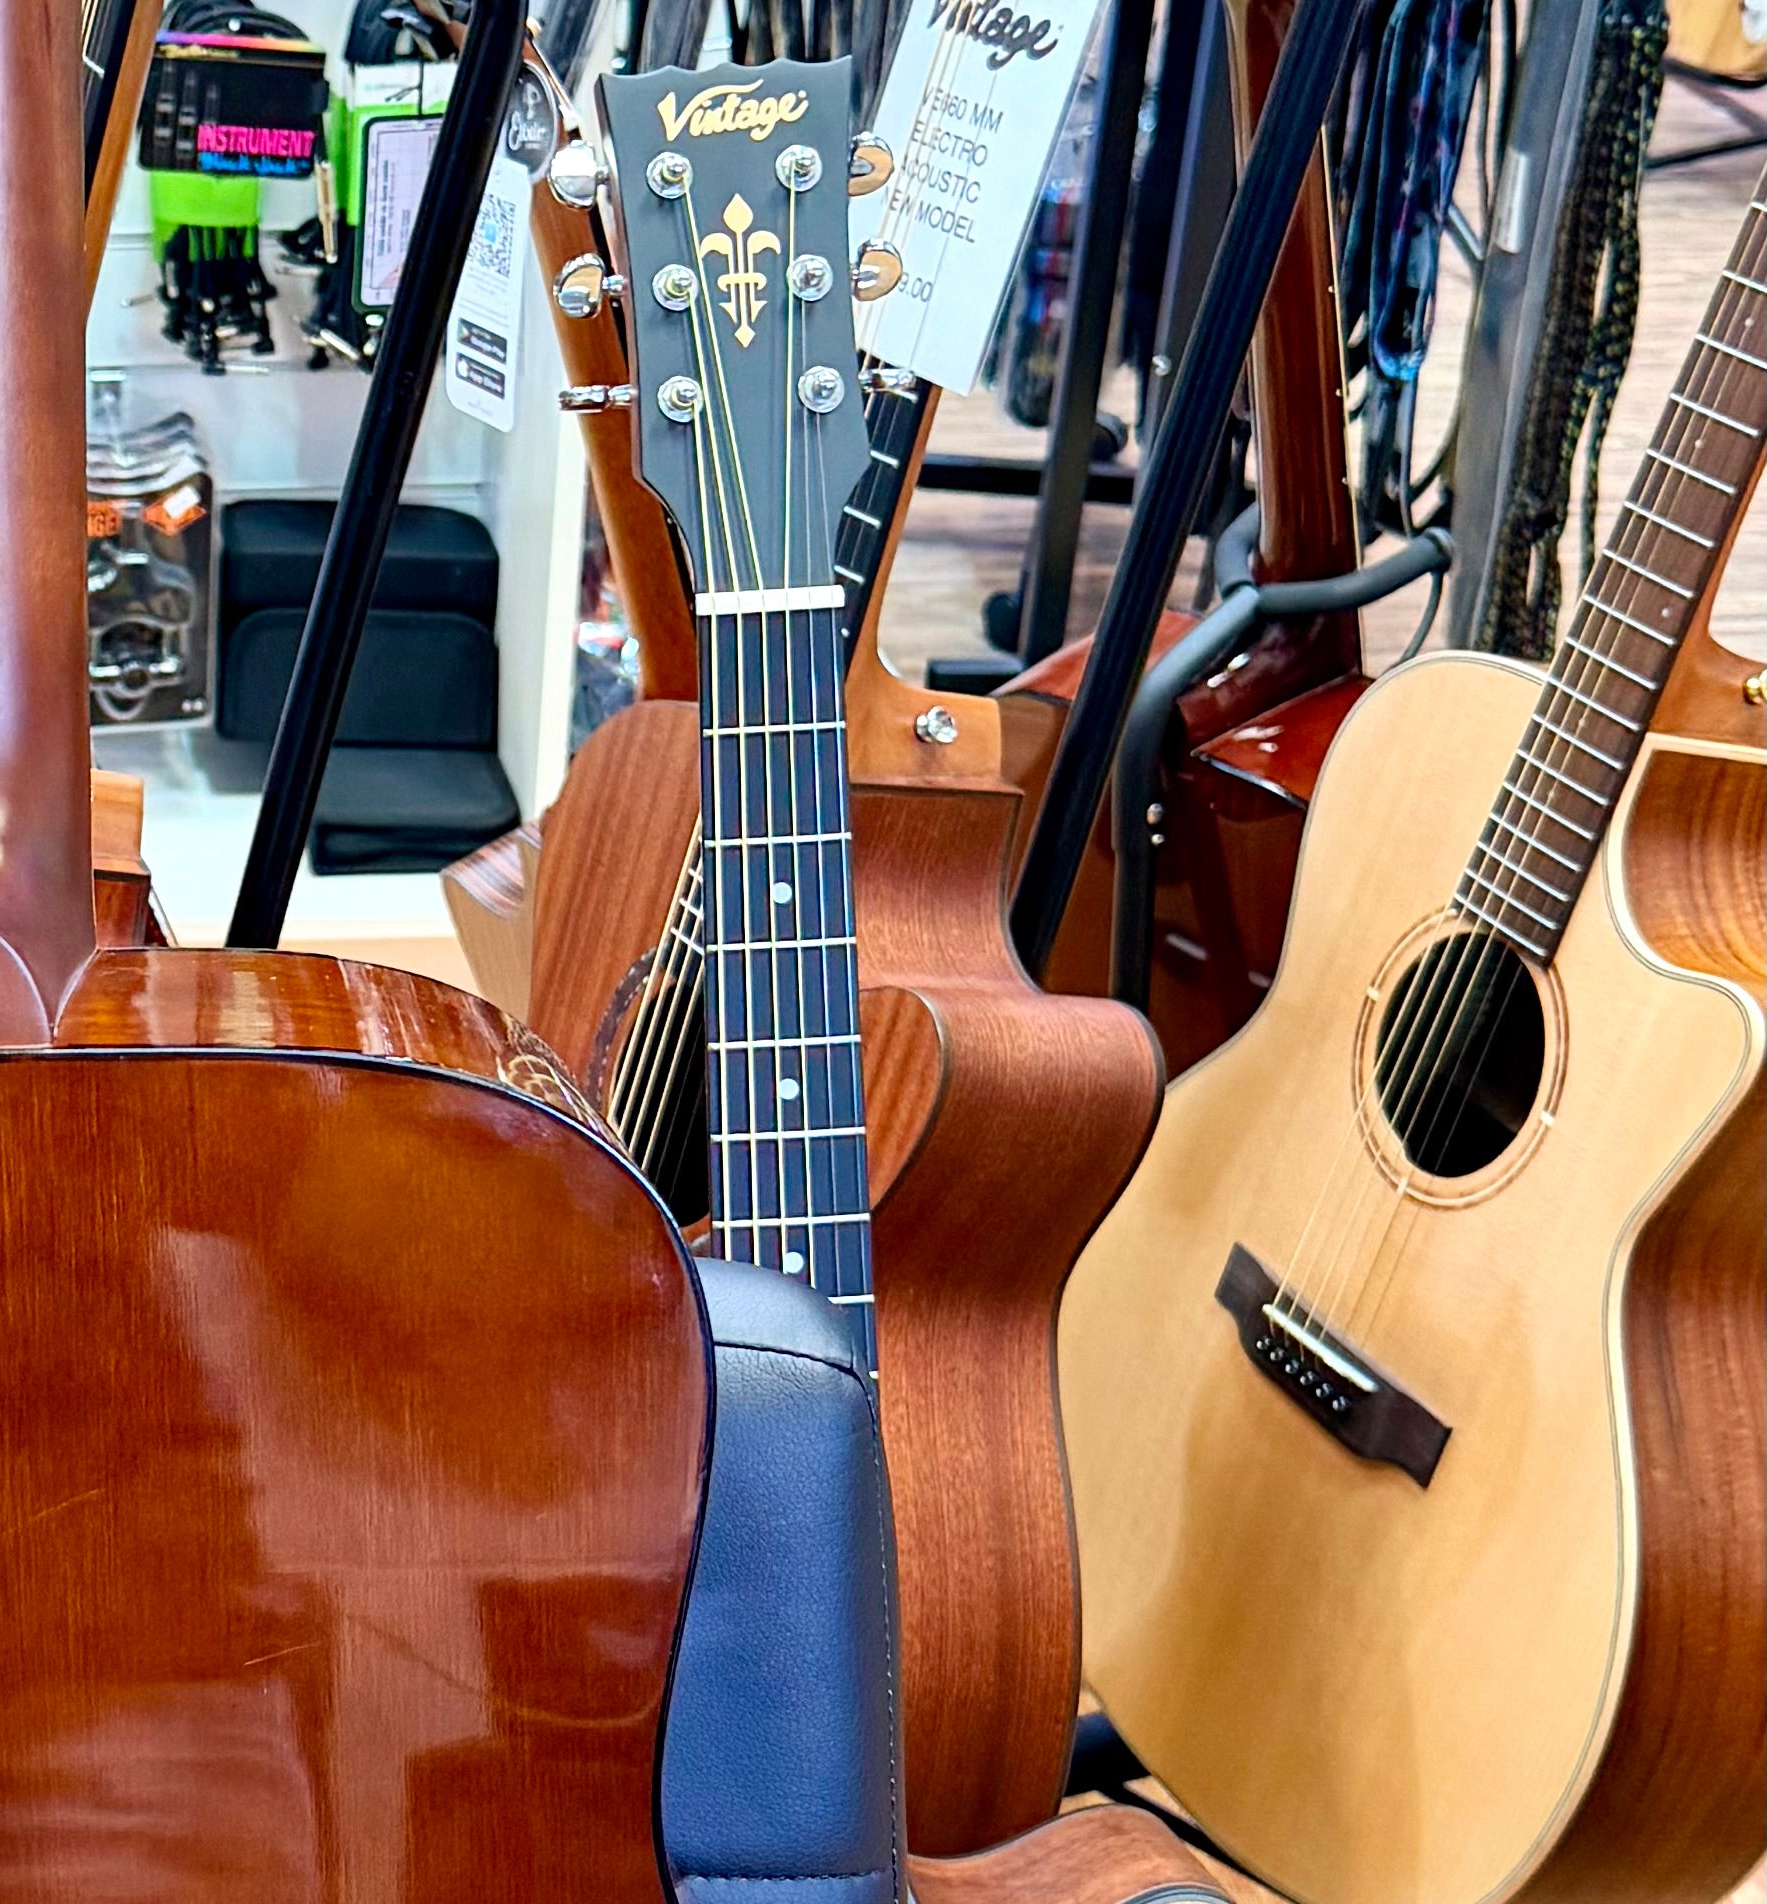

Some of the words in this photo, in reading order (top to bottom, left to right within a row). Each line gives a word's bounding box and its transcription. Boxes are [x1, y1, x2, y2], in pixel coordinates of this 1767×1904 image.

[657, 79, 809, 142] Vintage
[969, 102, 1004, 134] MM
[197, 122, 317, 159] INSTRUMENT
[910, 118, 989, 168] ELECTRO
[914, 200, 976, 244] MODEL
